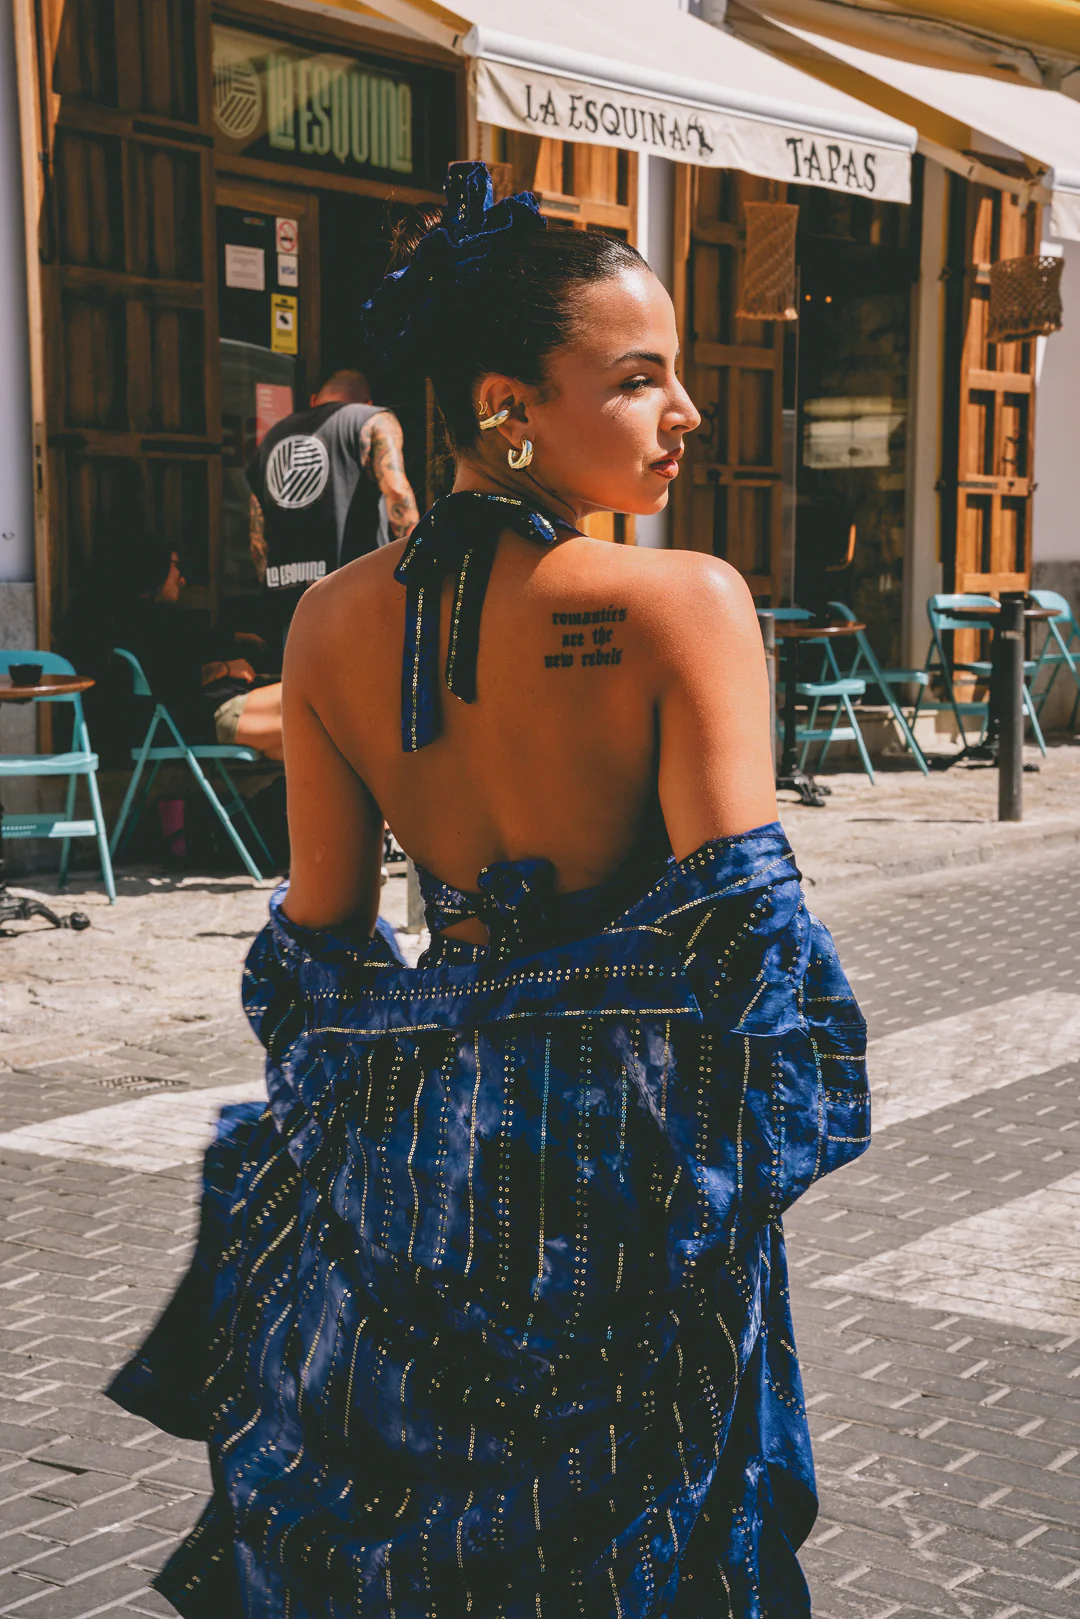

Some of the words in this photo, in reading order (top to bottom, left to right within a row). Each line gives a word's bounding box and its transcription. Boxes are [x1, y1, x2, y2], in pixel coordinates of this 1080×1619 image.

[267, 54, 295, 151] LA
[298, 60, 413, 174] ESQUINA
[523, 84, 559, 126] LA
[568, 95, 688, 151] ESQUINA
[785, 137, 877, 192] TAPAS
[266, 566, 279, 588] LA
[280, 560, 326, 586] ESQUINA
[562, 632, 584, 647] are
[592, 626, 613, 646] the
[544, 652, 574, 668] new
[581, 648, 623, 667] rebels
